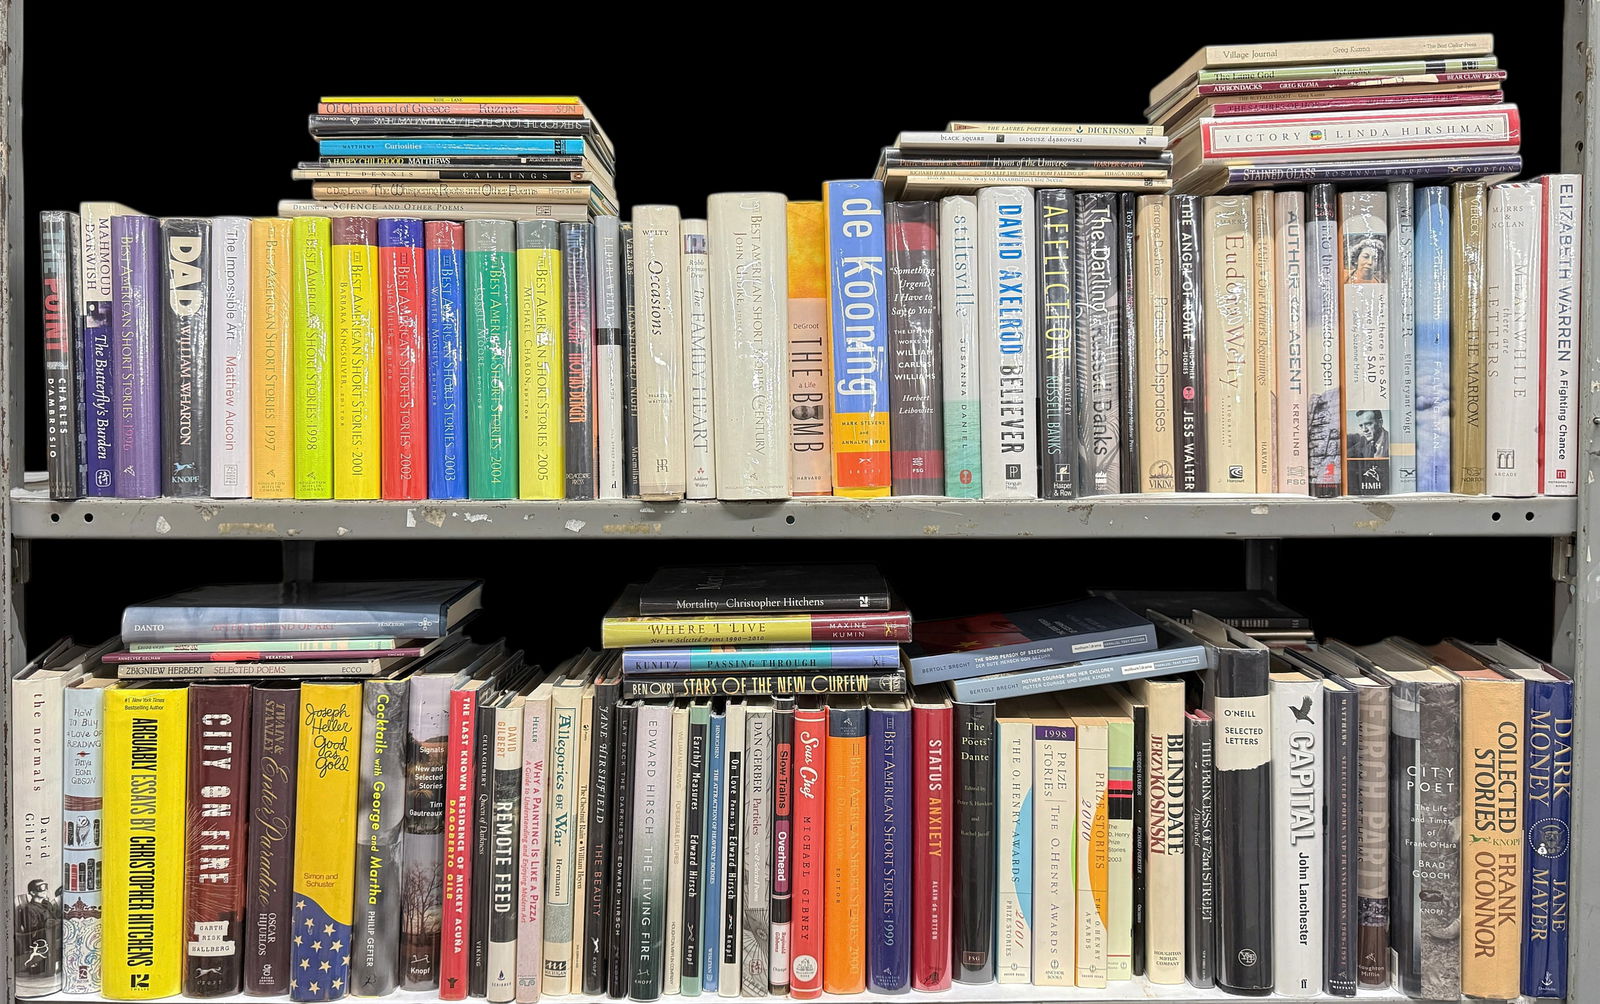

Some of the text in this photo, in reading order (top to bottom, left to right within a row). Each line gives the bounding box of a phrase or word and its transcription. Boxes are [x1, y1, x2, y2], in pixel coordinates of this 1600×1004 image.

[1214, 84, 1262, 93] ADIRONDACKS
[1298, 81, 1319, 89] KUZMA
[1223, 48, 1278, 60] Village Journal
[992, 158, 1068, 168] Hymn of the Universe
[1088, 126, 1135, 135] DICKINSON
[1224, 122, 1496, 144] VICTORY LINDA HIRSHMAN
[332, 202, 378, 210] SCIENCE
[462, 172, 548, 180] CALLINGS
[1558, 184, 1575, 279] ELIZABETH
[836, 198, 884, 396] de Kooning
[1043, 205, 1070, 360] AFFLICTION
[94, 335, 108, 352] The
[170, 236, 202, 446] DAD WILLIAM WHARTON
[224, 230, 238, 451] The Impossible Art Matthew Aucoin
[954, 214, 974, 449] stiltsville SUSANNA DANIEL
[998, 204, 1025, 454] DAVID AXELROD BELIEVER
[1488, 284, 1500, 378] LETTERS
[1557, 285, 1573, 362] WARREN
[352, 264, 364, 476] BEST AMERICAN SHORT STORIES 2001
[1151, 297, 1168, 432] Praises & Dispraises
[1402, 354, 1413, 434] Ellen Bryant Voigt
[1556, 380, 1568, 422] Fighting
[48, 378, 58, 459] D'AMBROSIO
[59, 378, 68, 434] CHARLES
[96, 418, 112, 460] Burden
[1046, 376, 1062, 454] RUSSELL BANKS
[1292, 403, 1300, 456] KREYLING
[1558, 424, 1568, 460] Chance
[1183, 410, 1196, 490] JESS WALTER
[134, 624, 164, 632] DANTO
[676, 597, 825, 610] Mortality Christopher Hitchens
[832, 631, 866, 639] KUMIN
[126, 666, 166, 676] ZBIGNIEW
[168, 666, 204, 675] HERBERT
[214, 666, 254, 674] SELECTED
[256, 666, 286, 674] POEMS
[632, 675, 869, 696] BEN OKRI STARS OF THE NEW CURFEW
[636, 658, 817, 670] KUNITZ PASSING THROUGH
[33, 694, 46, 792] the normals
[554, 714, 572, 791] Allegories
[1040, 729, 1068, 738] 1998
[1224, 710, 1257, 719] O'NEILL
[1224, 727, 1264, 736] SELECTED
[1225, 737, 1259, 746] LETTERS
[752, 722, 764, 836] DAN GERBER Particles
[778, 750, 788, 809] Slow Trains
[1166, 733, 1184, 856] BLIND DATE
[1474, 748, 1496, 831] STORIES
[1498, 721, 1518, 833] COLLECTED
[1529, 708, 1552, 806] MONEY
[1552, 718, 1573, 800] DARK
[199, 713, 233, 884] CITY ON FIRE
[256, 756, 290, 906] Enter Paradise
[366, 694, 390, 967] Cocktails with George and Martha PHILIP GEFTER
[454, 697, 471, 954] THE LAST KNOWN RESIDENCE OF MICKEY ACUÑA
[554, 812, 569, 846] War
[688, 736, 703, 898] Earthly Measures Edward Hirsch
[928, 739, 942, 857] STATUS ANXIETY
[24, 813, 36, 866] Gilbert
[40, 816, 50, 859] David
[127, 718, 159, 966] ARGUABLY ESSAYS BY CHRISTOPHER HITCHENS
[446, 800, 456, 900] DAGOBERTO GILB
[494, 802, 514, 913] REMOTE FEED
[776, 832, 787, 882] Overhead
[883, 730, 896, 946] BEST AMERICAN SHORT STORIES 1999
[1289, 731, 1316, 946] CAPITAL John Lanchester
[554, 858, 564, 897] Hermann
[800, 816, 812, 941] MICHAEL GIBNEY
[1474, 851, 1496, 958] O'CONNOR
[1498, 852, 1517, 926] FRANK
[1530, 868, 1549, 942] MAYER
[1552, 878, 1566, 933] JANE
[258, 912, 270, 956] HIJUELOS
[266, 912, 277, 943] OSCAR
